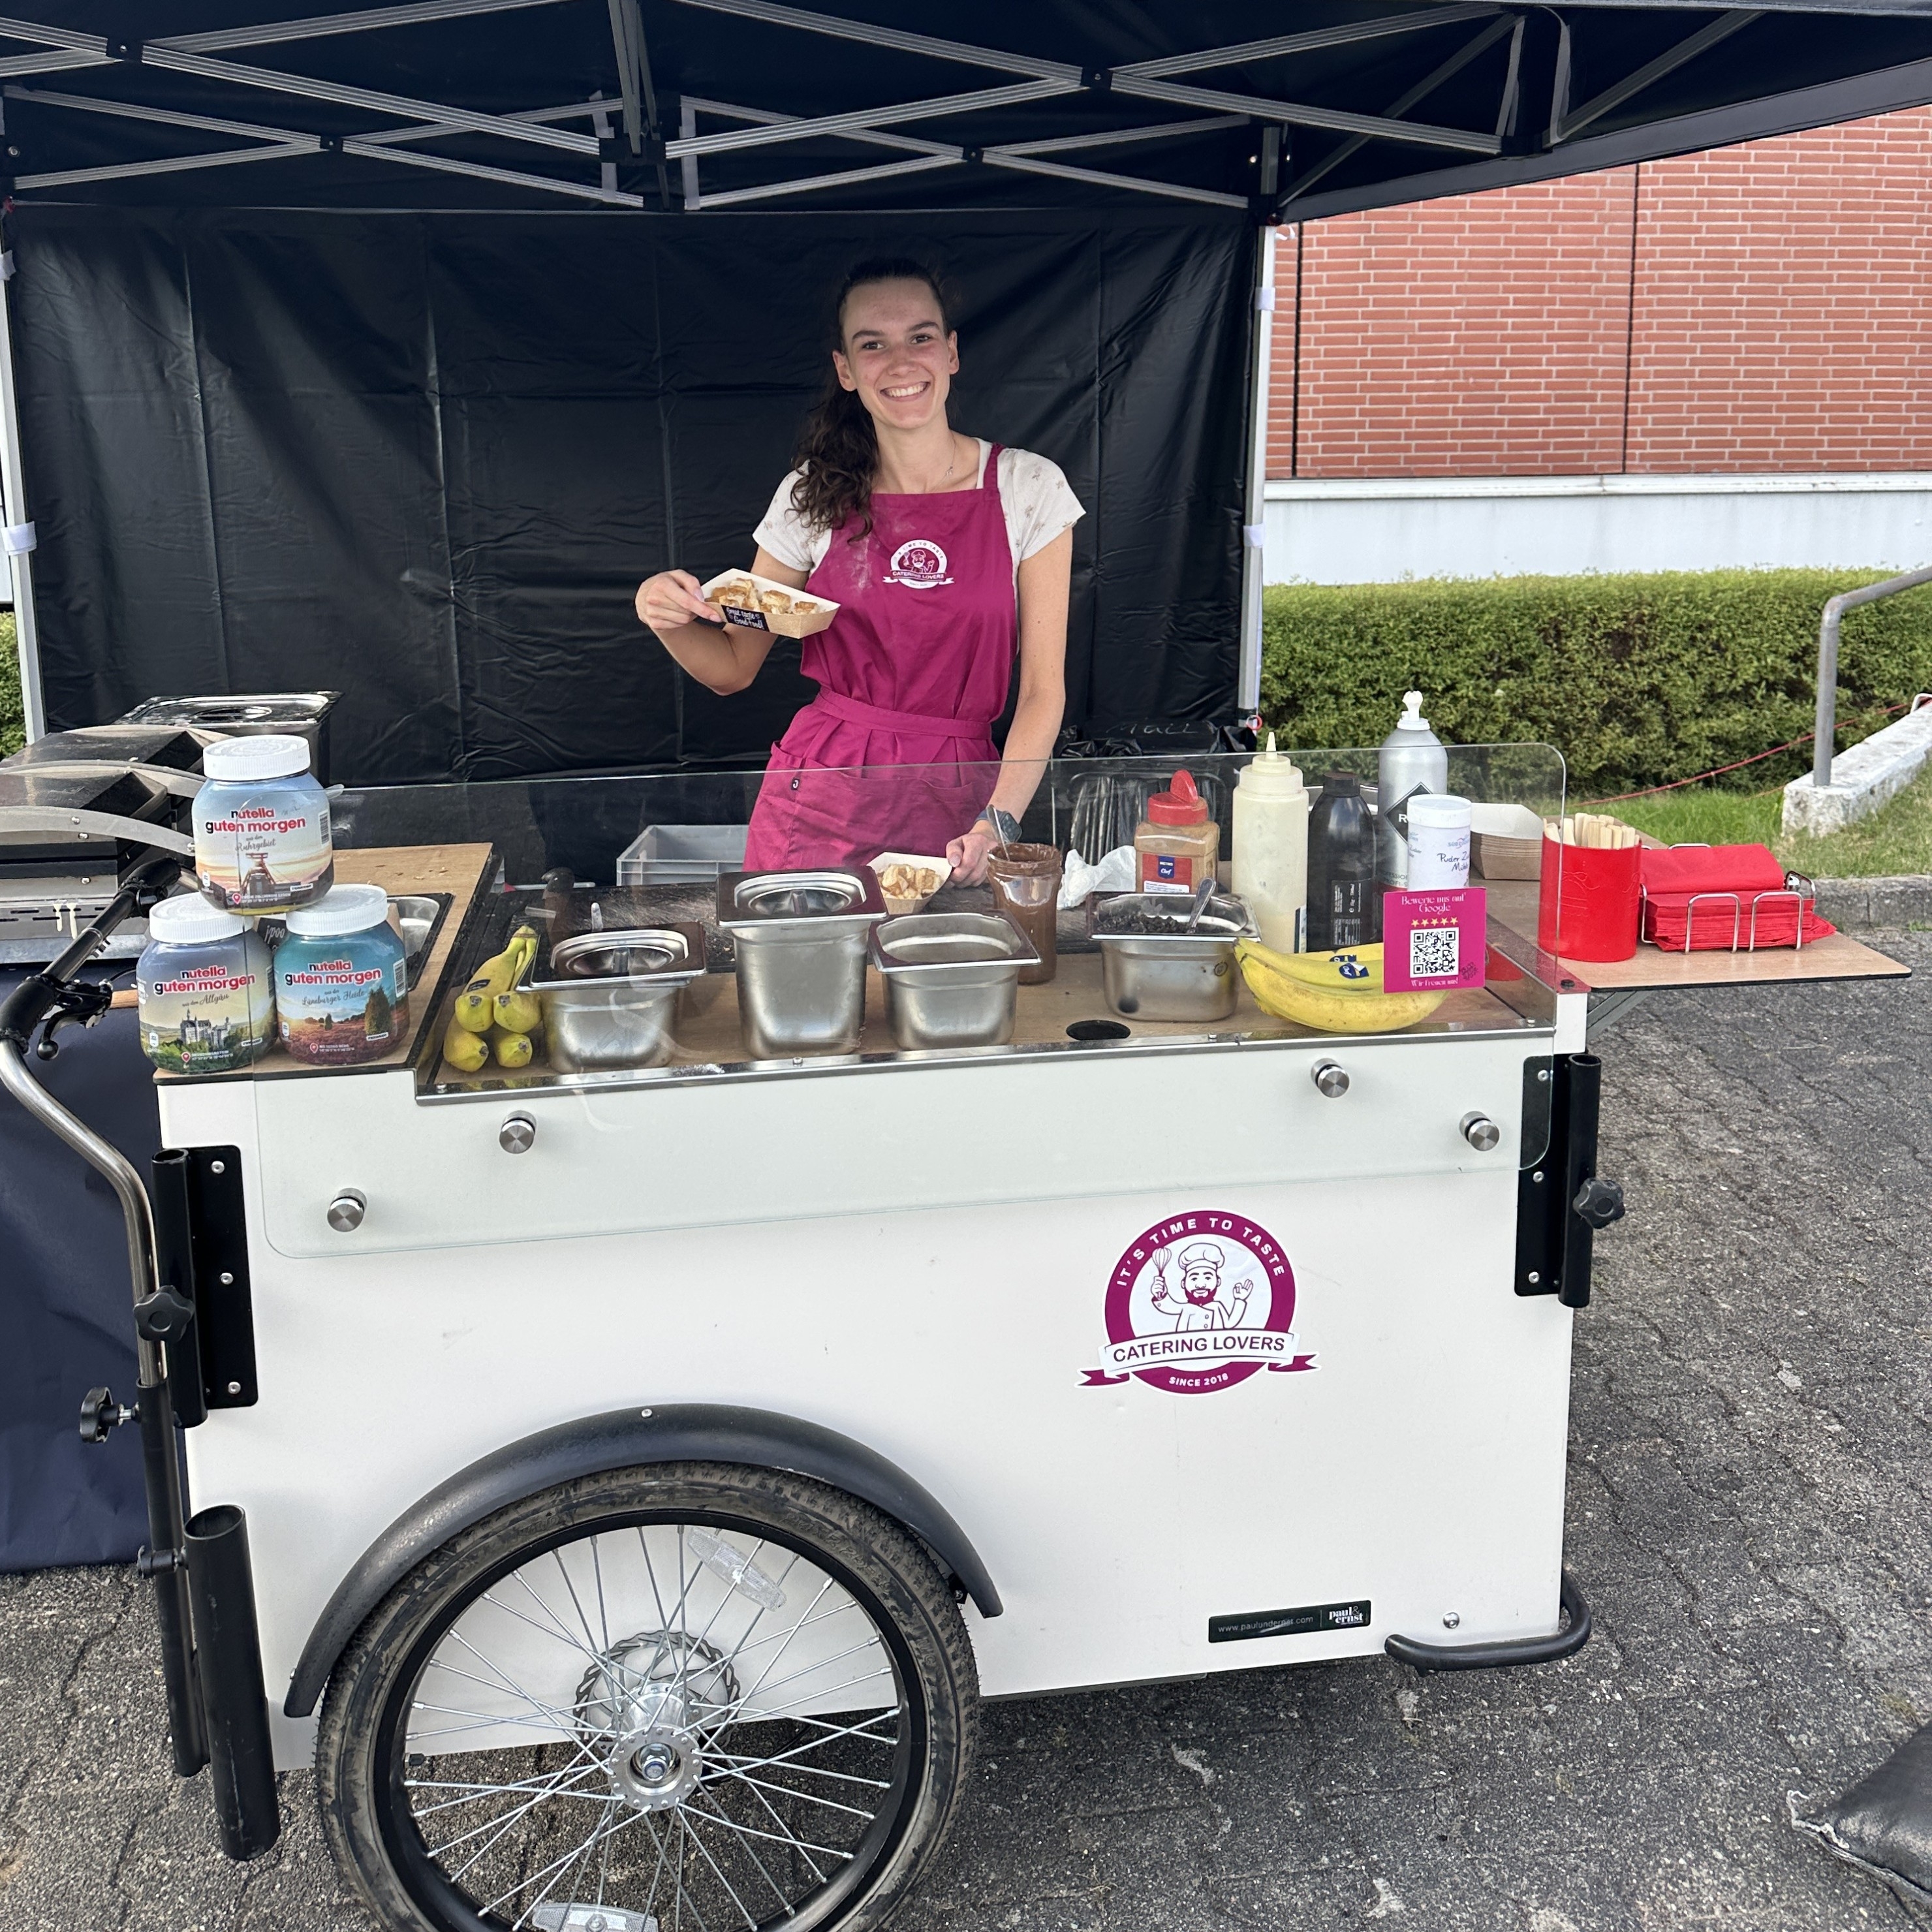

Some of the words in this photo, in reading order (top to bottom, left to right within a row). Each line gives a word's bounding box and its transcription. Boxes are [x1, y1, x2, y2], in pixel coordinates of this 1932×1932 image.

[231, 807, 274, 818] nutella
[206, 820, 244, 834] guten
[248, 817, 305, 833] morgen
[235, 838, 276, 852] Ruhrgebiet
[1437, 852, 1460, 863] Puder
[1401, 896, 1435, 905] Bewerte
[1452, 892, 1467, 902] auf
[1419, 903, 1451, 914] Google
[182, 966, 226, 979] nutella
[309, 961, 352, 971] nutella
[285, 973, 322, 986] guten
[326, 969, 381, 985] morgen
[155, 981, 195, 995] guten
[198, 974, 255, 990] morgen
[343, 989, 366, 1001] Heide
[1117, 1248, 1145, 1287] IT'S
[1149, 1218, 1198, 1245] TIME
[1209, 1217, 1233, 1231] TO
[1243, 1226, 1285, 1277] TASTE
[1113, 1338, 1208, 1362] CATERING
[1213, 1335, 1285, 1352] LOVERS
[1168, 1376, 1201, 1387] SINCE
[1204, 1373, 1229, 1385] 2018
[1335, 1613, 1363, 1624] ernst
